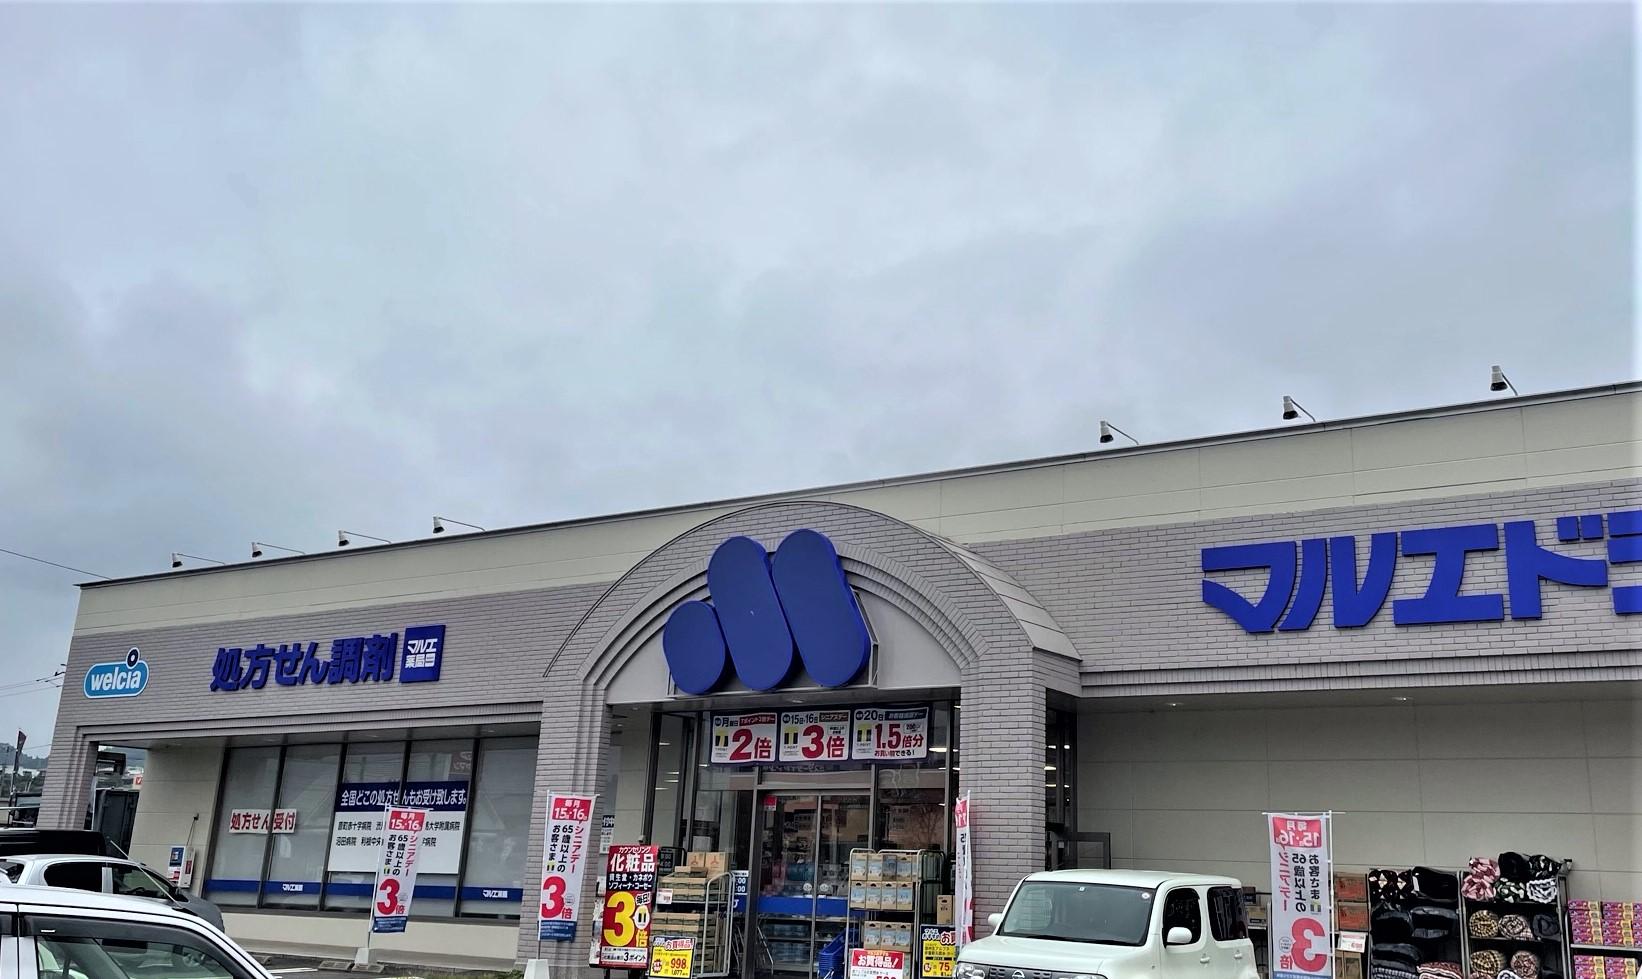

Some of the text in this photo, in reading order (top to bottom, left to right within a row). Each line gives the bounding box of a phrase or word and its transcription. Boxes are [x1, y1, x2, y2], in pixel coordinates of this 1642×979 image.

[210, 632, 398, 691] 処方せん調剤
[407, 638, 438, 654] マルエ
[90, 664, 141, 692] welcia
[729, 728, 772, 760] 2倍
[802, 724, 845, 758] 3倍
[564, 800, 581, 808] 毎月
[230, 811, 295, 831] 処方せん受付
[384, 834, 397, 865] お客さま
[392, 834, 408, 876] 65歳以上の
[548, 825, 561, 861] お客さま
[557, 825, 573, 873] 65歳以上の
[610, 853, 655, 873] 化粧品
[377, 878, 405, 916] 3倍
[541, 876, 573, 920] 3倍
[670, 958, 687, 969] 998
